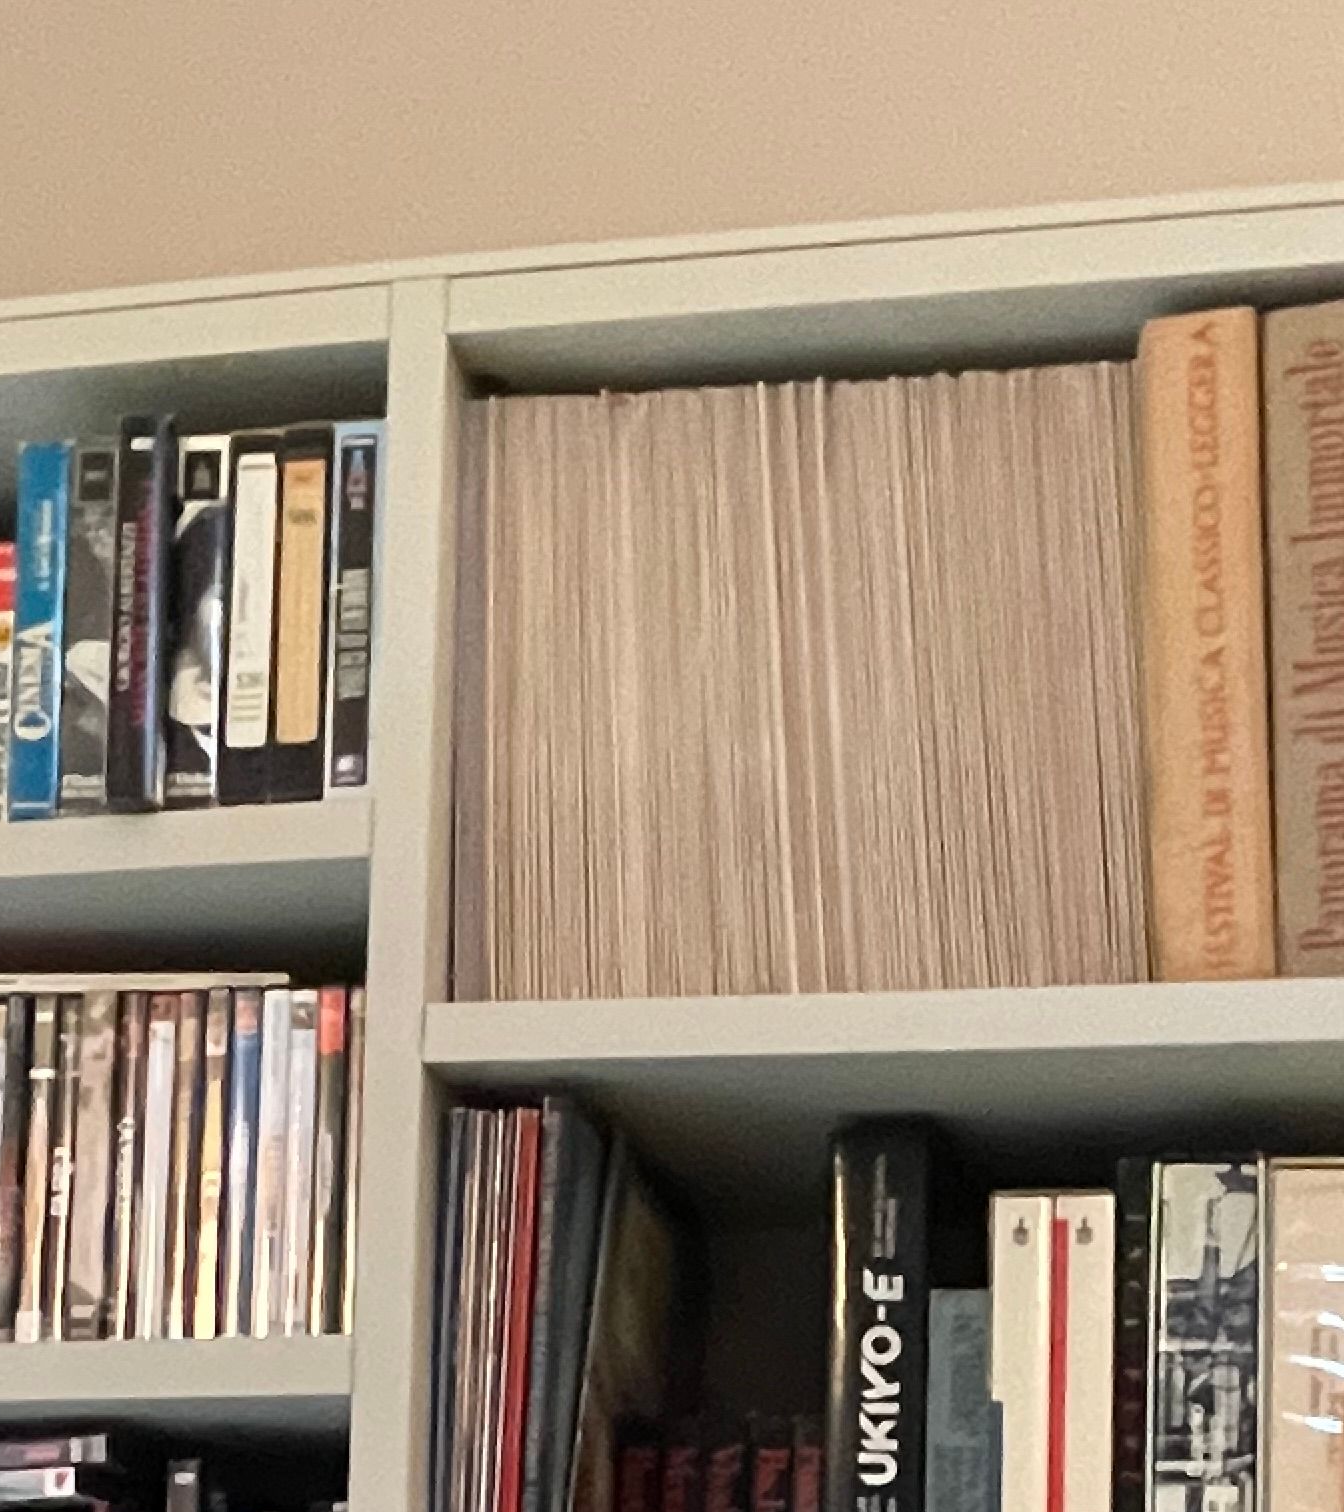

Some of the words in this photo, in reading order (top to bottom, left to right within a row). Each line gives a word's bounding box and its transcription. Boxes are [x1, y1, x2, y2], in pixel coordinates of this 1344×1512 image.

[13, 622, 55, 742] CINEMA
[1193, 645, 1228, 776] MUSICA
[859, 1266, 906, 1487] UKIYO-E
